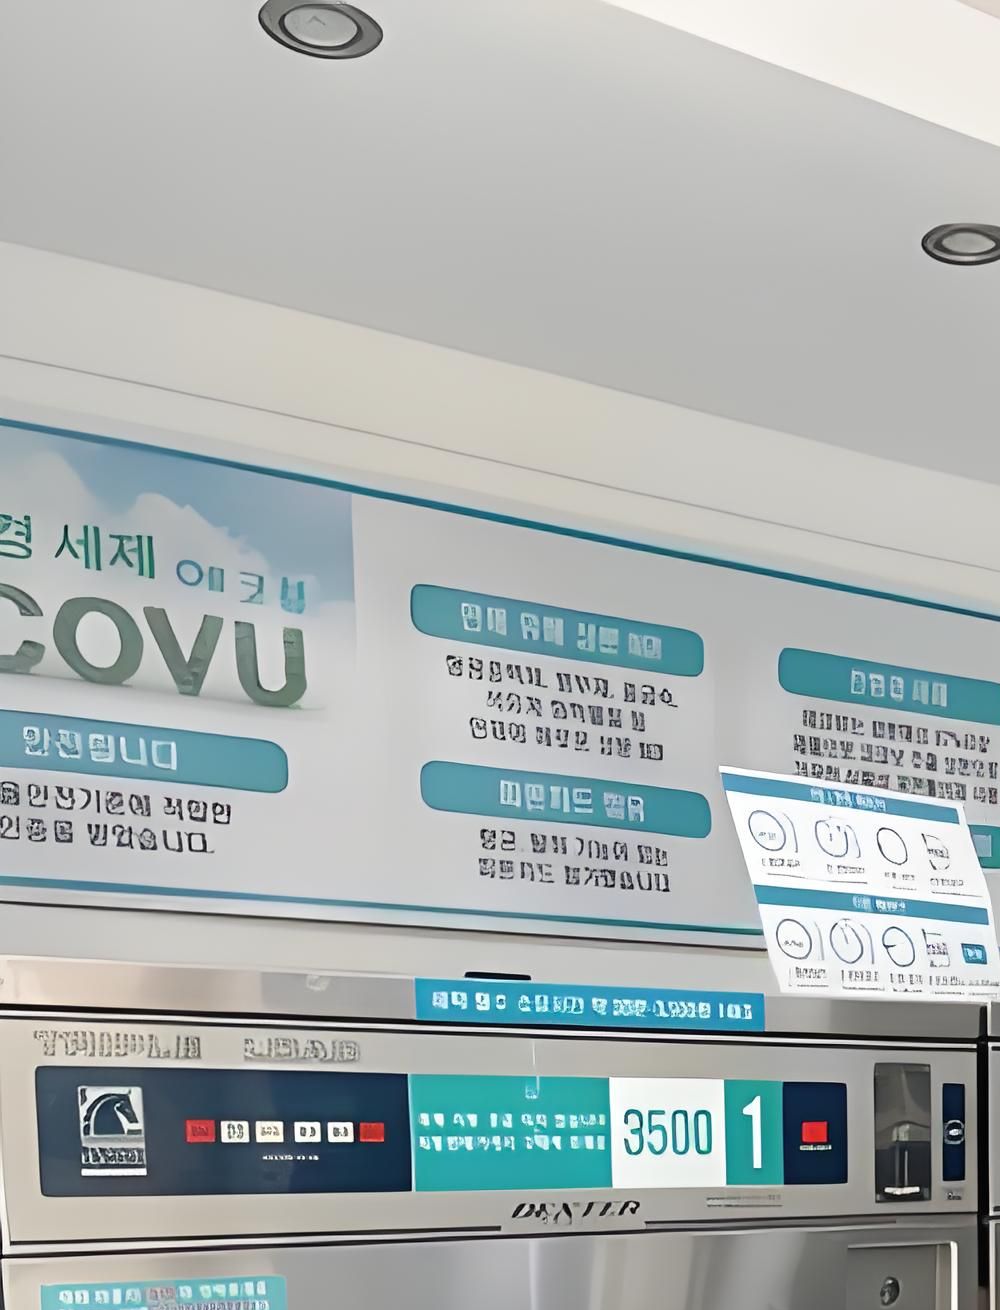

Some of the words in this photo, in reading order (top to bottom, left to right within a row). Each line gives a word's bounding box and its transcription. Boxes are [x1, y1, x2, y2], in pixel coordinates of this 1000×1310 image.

[54, 524, 155, 579] 세제
[623, 1108, 713, 1156] 3500
[742, 1095, 762, 1169] 1
